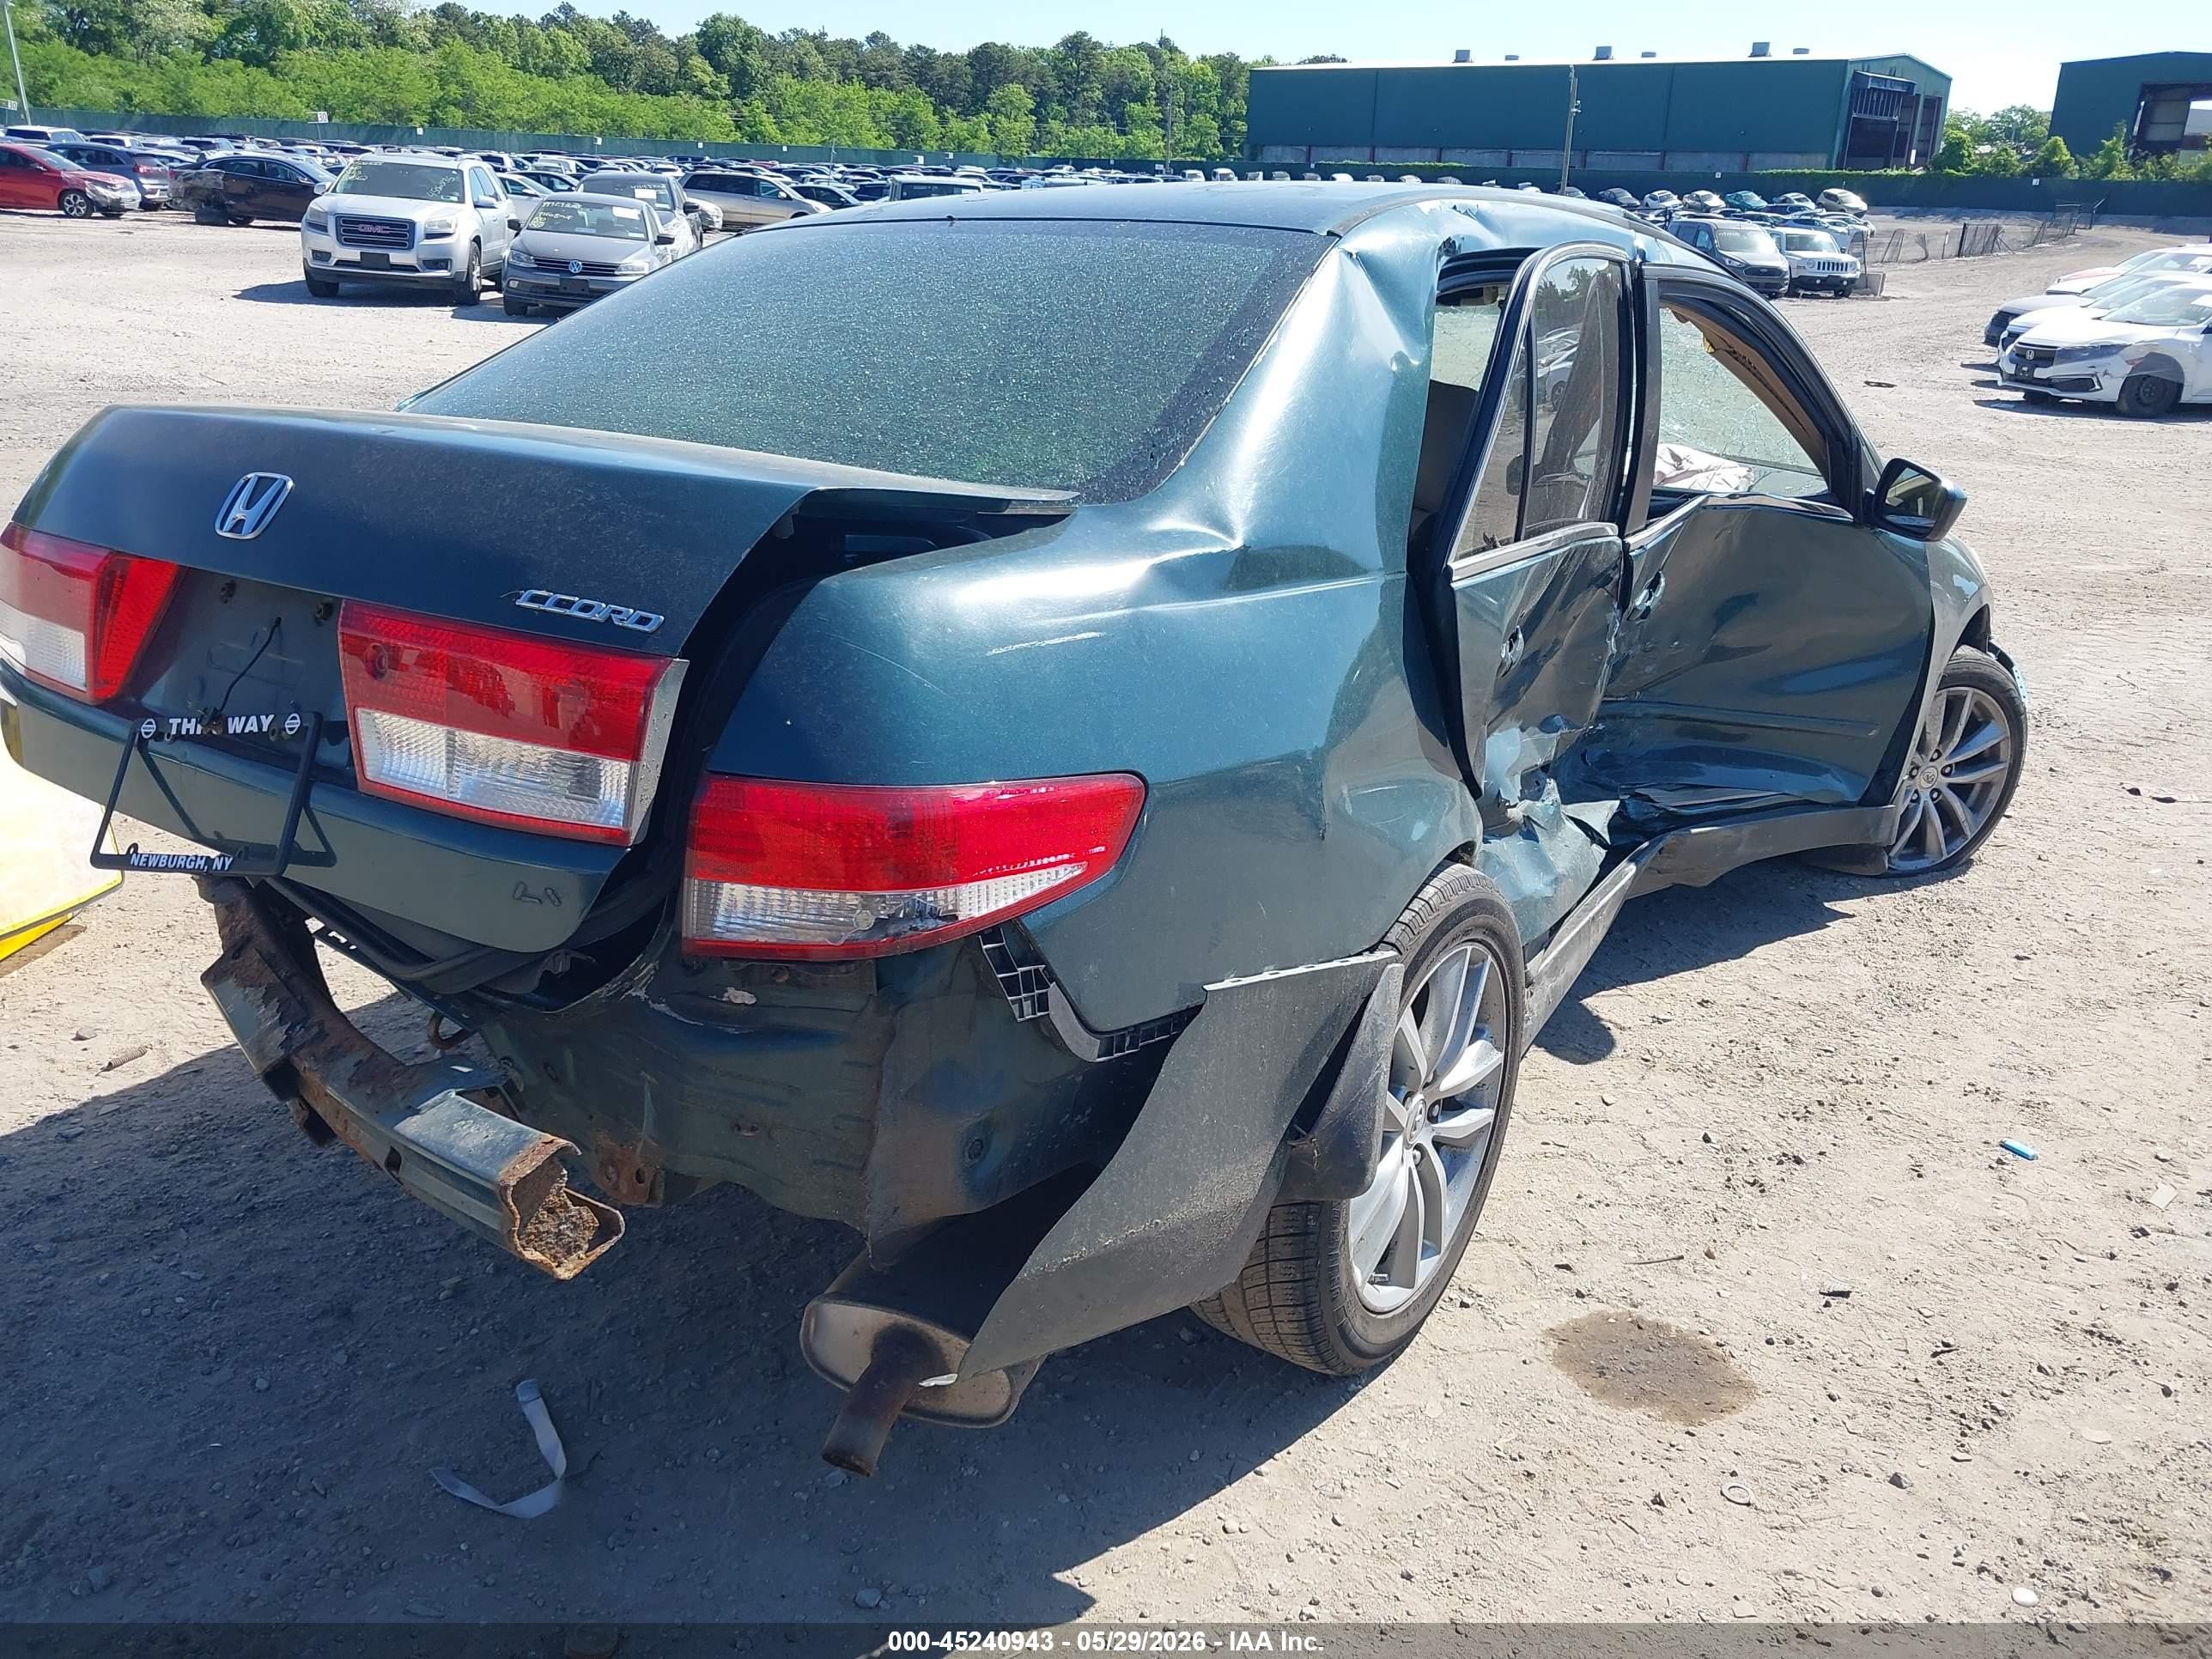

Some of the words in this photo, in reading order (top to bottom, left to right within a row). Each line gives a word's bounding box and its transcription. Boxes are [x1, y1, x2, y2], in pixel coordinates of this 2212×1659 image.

[357, 224, 390, 234] GMC
[515, 589, 665, 633] CCORD
[168, 718, 220, 735] THI
[227, 714, 274, 734] WAY
[130, 854, 208, 872] NEWBURGH,
[211, 857, 234, 871] NY
